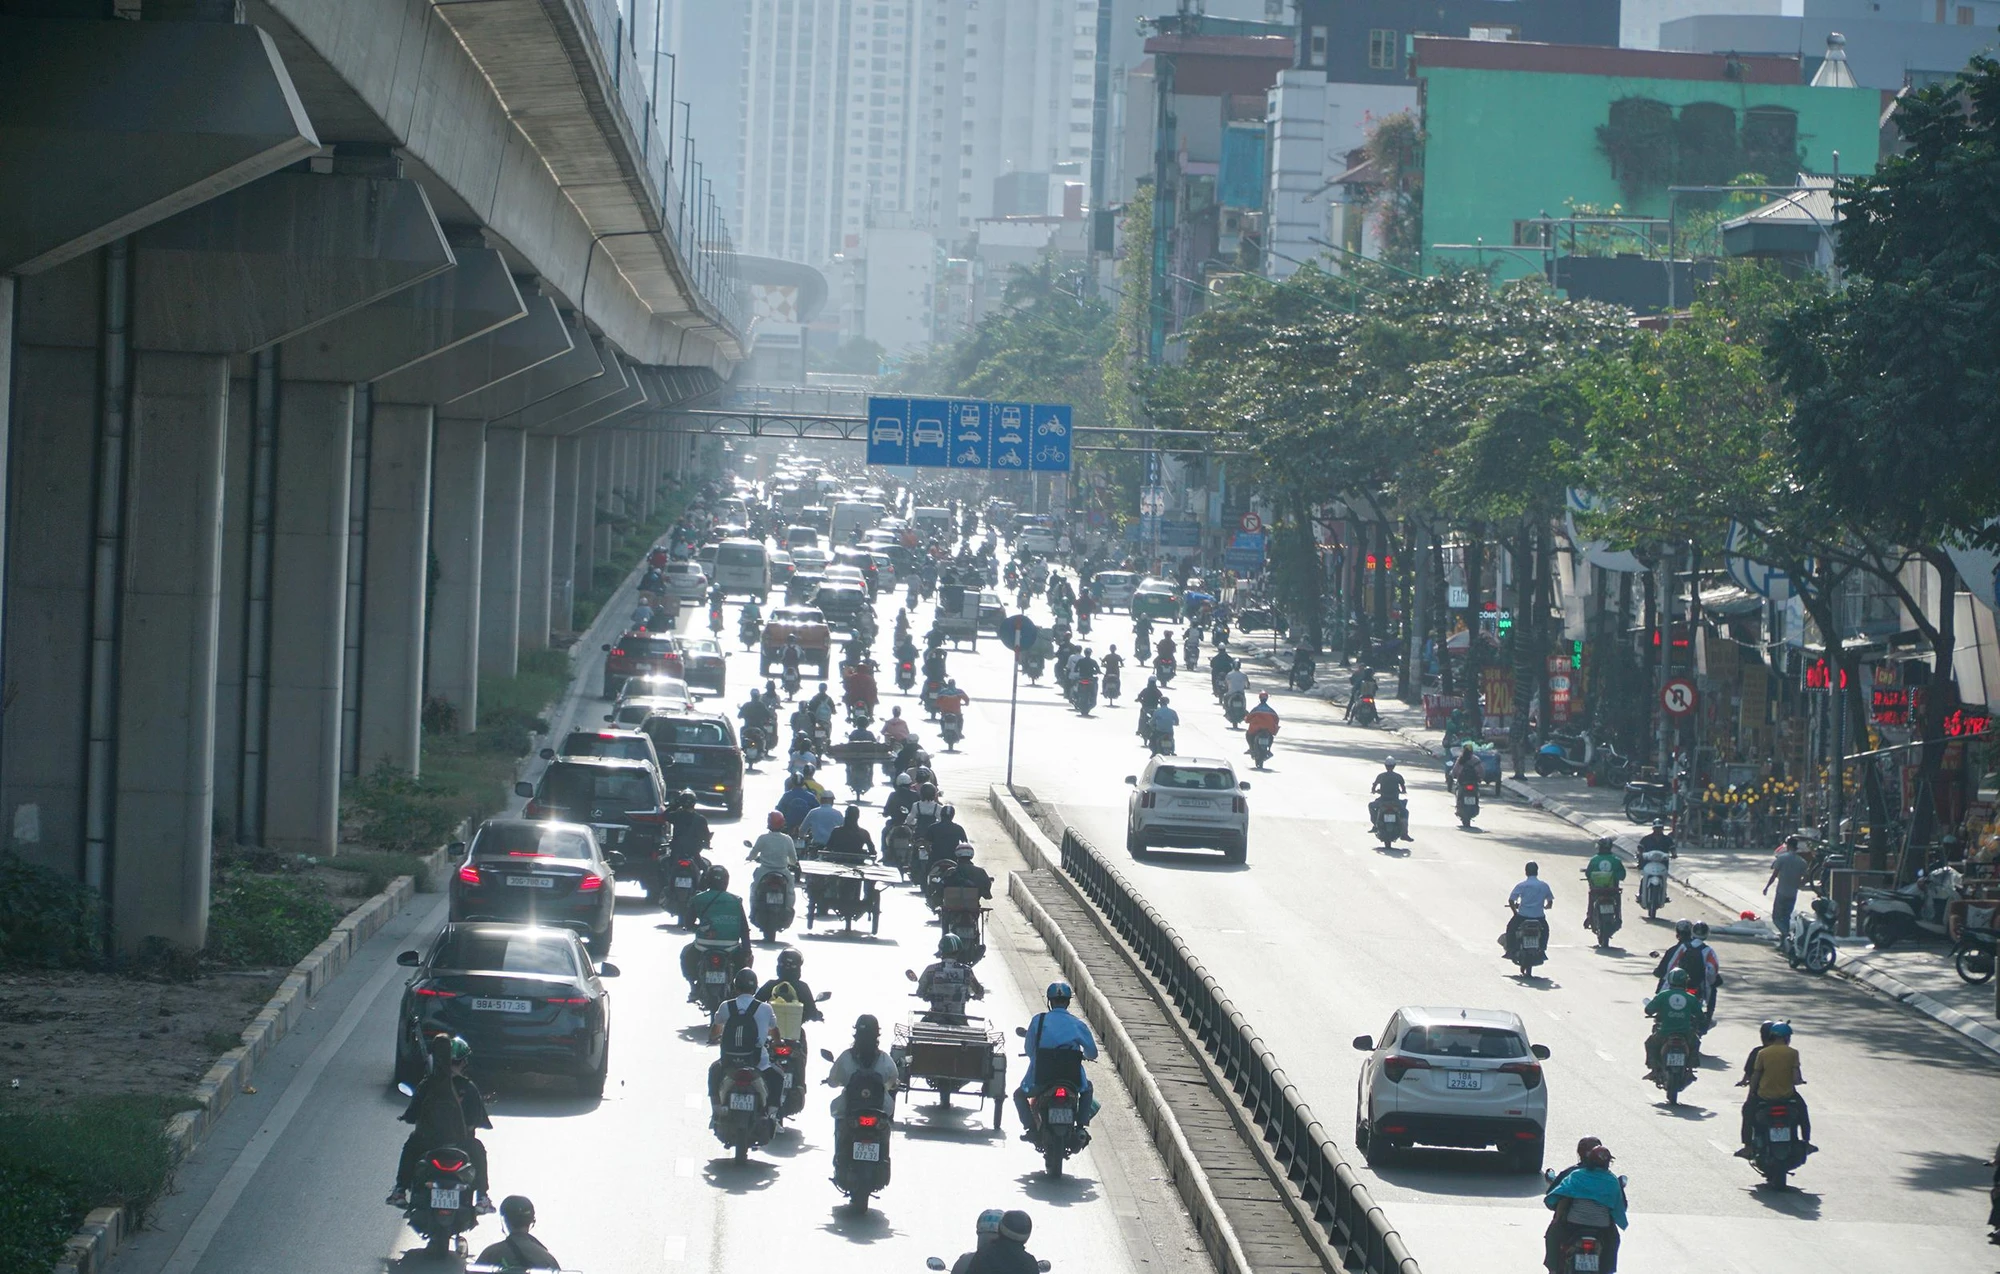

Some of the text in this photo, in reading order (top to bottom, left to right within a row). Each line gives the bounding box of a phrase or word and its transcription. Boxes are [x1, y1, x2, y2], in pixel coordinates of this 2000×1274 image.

[476, 1000, 526, 1011] 98A-517.36
[1459, 1072, 1472, 1080] 18A
[1451, 1080, 1477, 1088] 279.49
